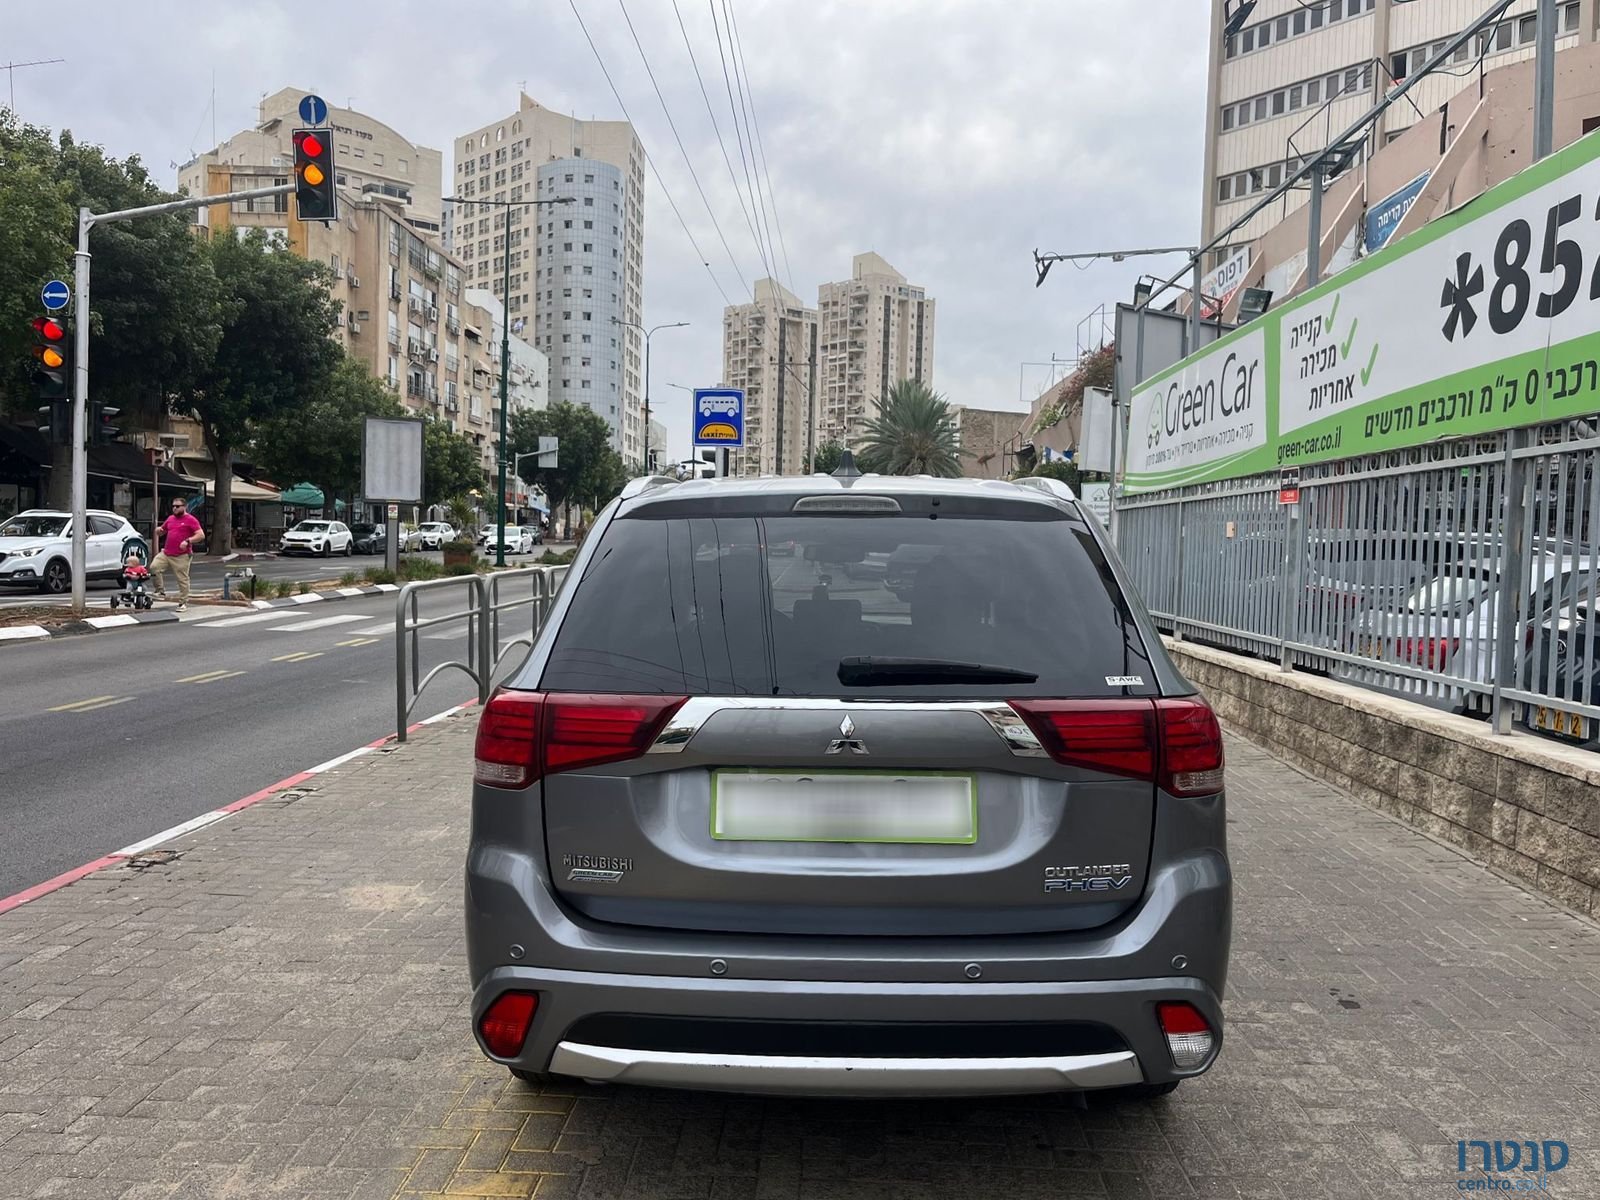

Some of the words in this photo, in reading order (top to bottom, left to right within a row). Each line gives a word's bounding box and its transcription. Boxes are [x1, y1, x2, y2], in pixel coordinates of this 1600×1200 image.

[1378, 204, 1401, 228] קדימה
[1218, 255, 1244, 287] דפוס
[1291, 314, 1322, 349] קנייה
[1300, 344, 1337, 380] מכירה
[1165, 379, 1215, 437] Green
[1220, 352, 1259, 417] Car
[1309, 373, 1355, 412] אחריות
[1525, 368, 1540, 405] 0
[1546, 360, 1598, 400] רכבי
[1365, 405, 1413, 438] חדשים
[1418, 390, 1474, 427] ורכבים
[1277, 425, 1342, 464] green-car.co.il
[563, 854, 633, 871] MITSUBISHI
[1044, 864, 1130, 877] OUTLANDER
[1044, 876, 1132, 892] PHEV
